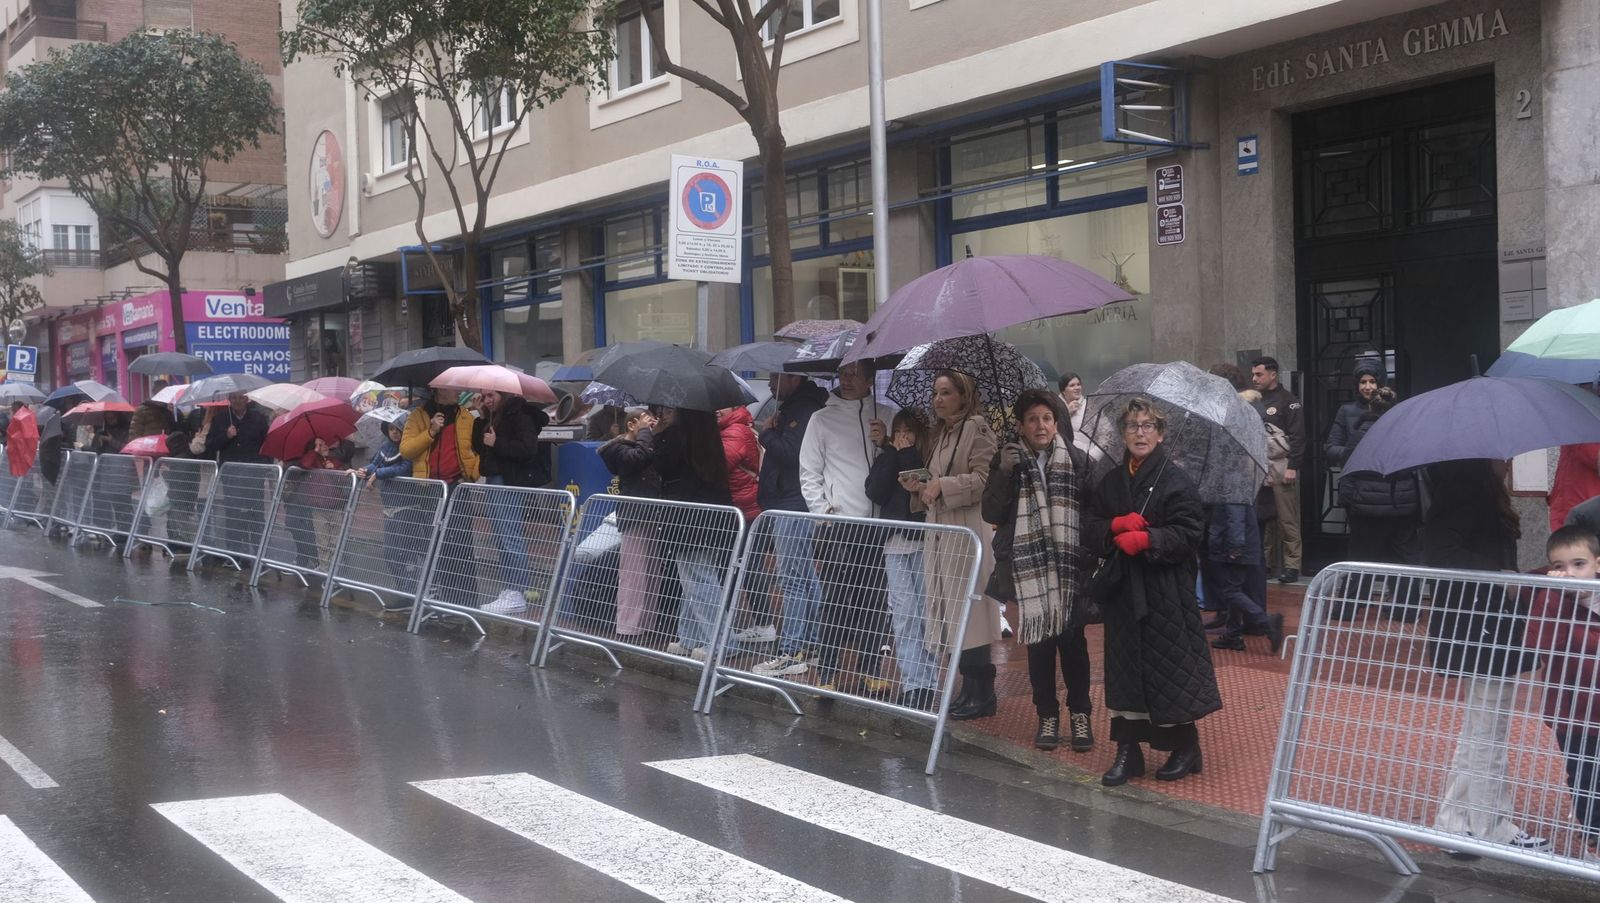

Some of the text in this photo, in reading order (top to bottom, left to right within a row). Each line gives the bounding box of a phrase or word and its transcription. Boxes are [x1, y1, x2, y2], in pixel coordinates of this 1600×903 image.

[1252, 9, 1510, 92] Edf. SANTA GEMMA
[1516, 89, 1532, 119] 2
[696, 159, 720, 169] R.O.A.
[207, 298, 264, 316] Venta
[195, 350, 291, 362] ENTREGAMOS
[244, 363, 263, 374] EN
